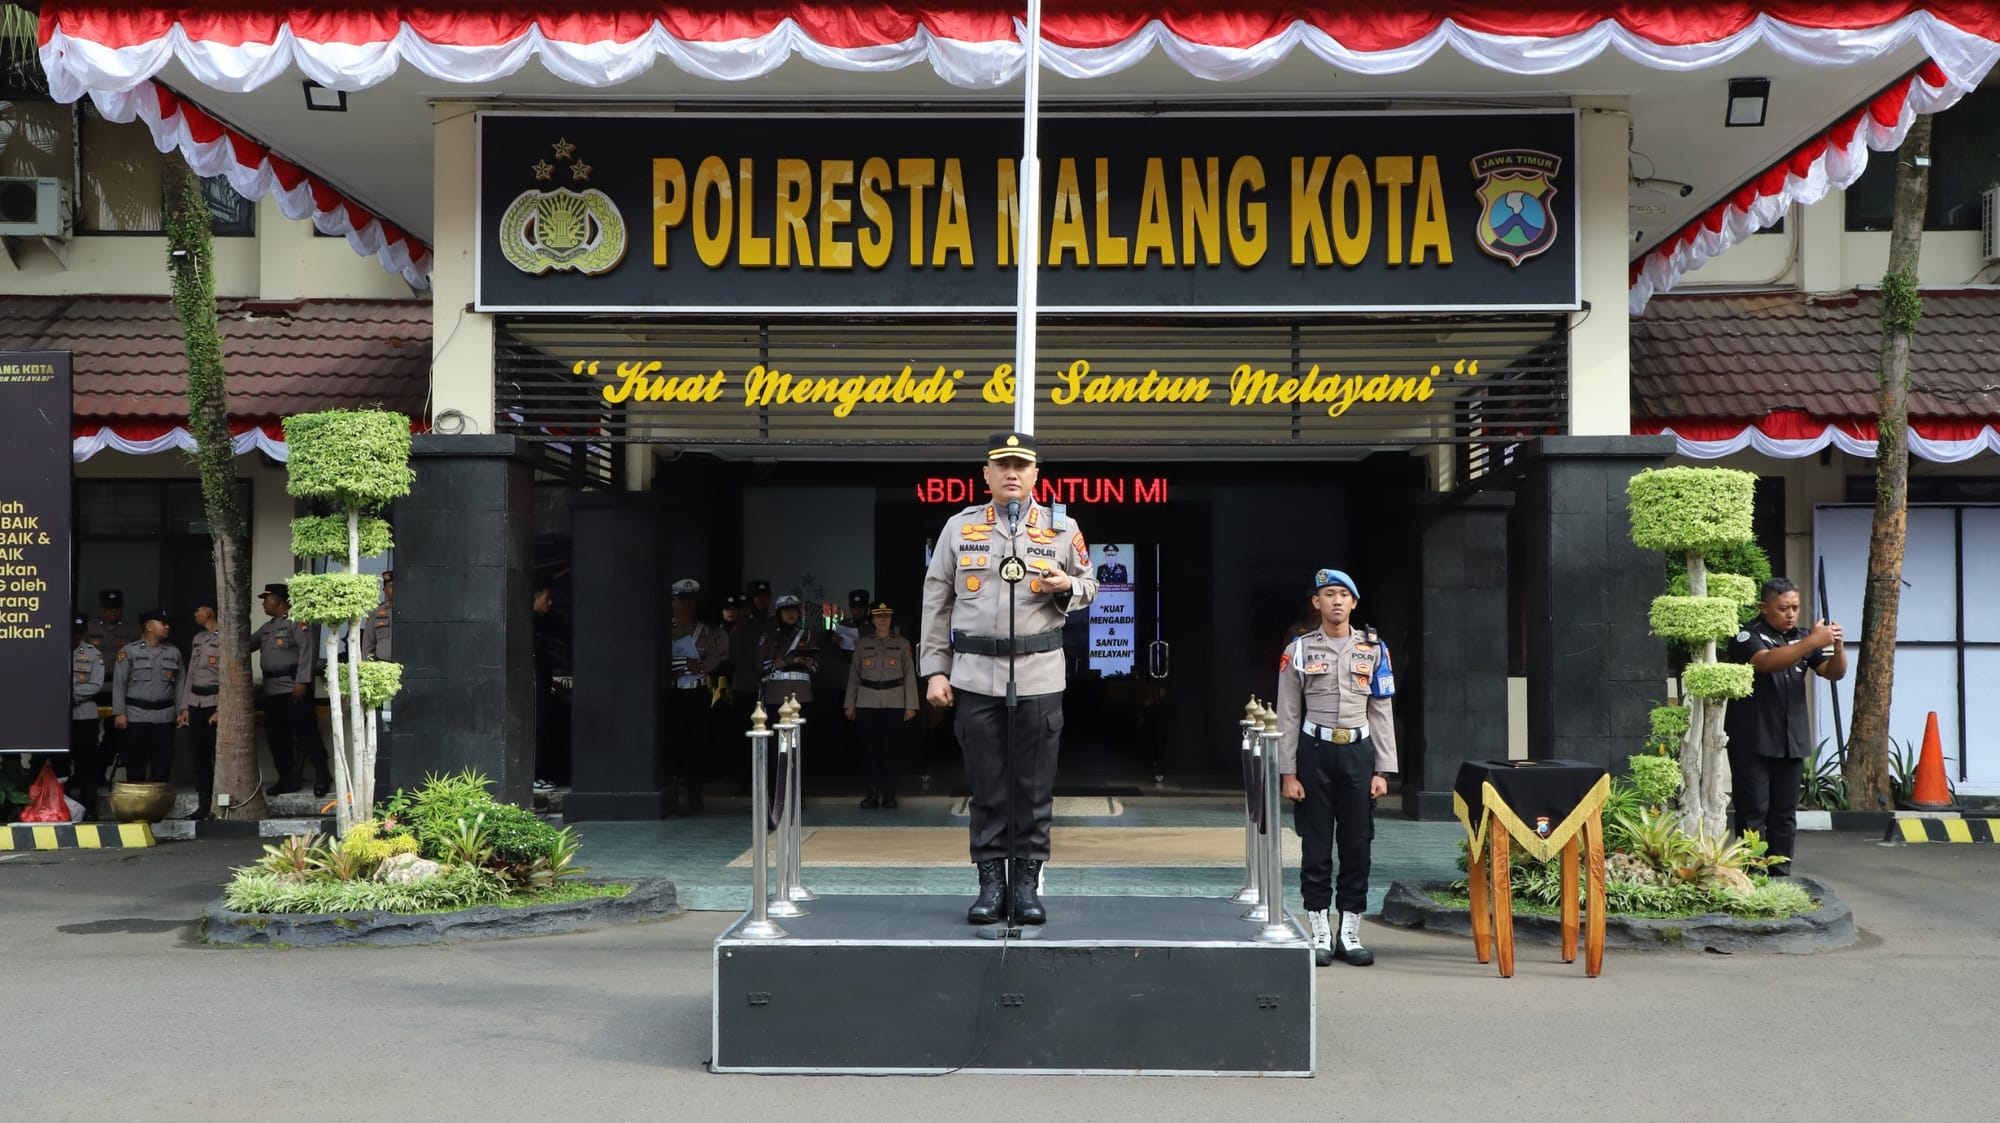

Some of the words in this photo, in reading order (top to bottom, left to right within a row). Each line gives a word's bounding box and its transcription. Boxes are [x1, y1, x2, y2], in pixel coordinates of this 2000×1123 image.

[1482, 155, 1512, 168] JAWA
[1516, 155, 1553, 168] TIMUR
[652, 156, 975, 268] POLRESTA
[997, 155, 1268, 267] MALANG
[1291, 154, 1453, 266] KOTA
[22, 364, 55, 375] KOTA
[744, 364, 965, 418] Mengabdi
[982, 363, 1016, 404] &
[1051, 360, 1212, 406] Santun
[1, 516, 39, 529] BAIK
[38, 531, 51, 545] &
[1026, 546, 1056, 559] POLRI
[10, 578, 47, 592] oleh
[1090, 616, 1135, 625] MENGABDI
[1108, 627, 1116, 636] &
[1095, 638, 1129, 648] SANTUN
[1307, 653, 1327, 661] REY
[1351, 652, 1374, 662] POLRI
